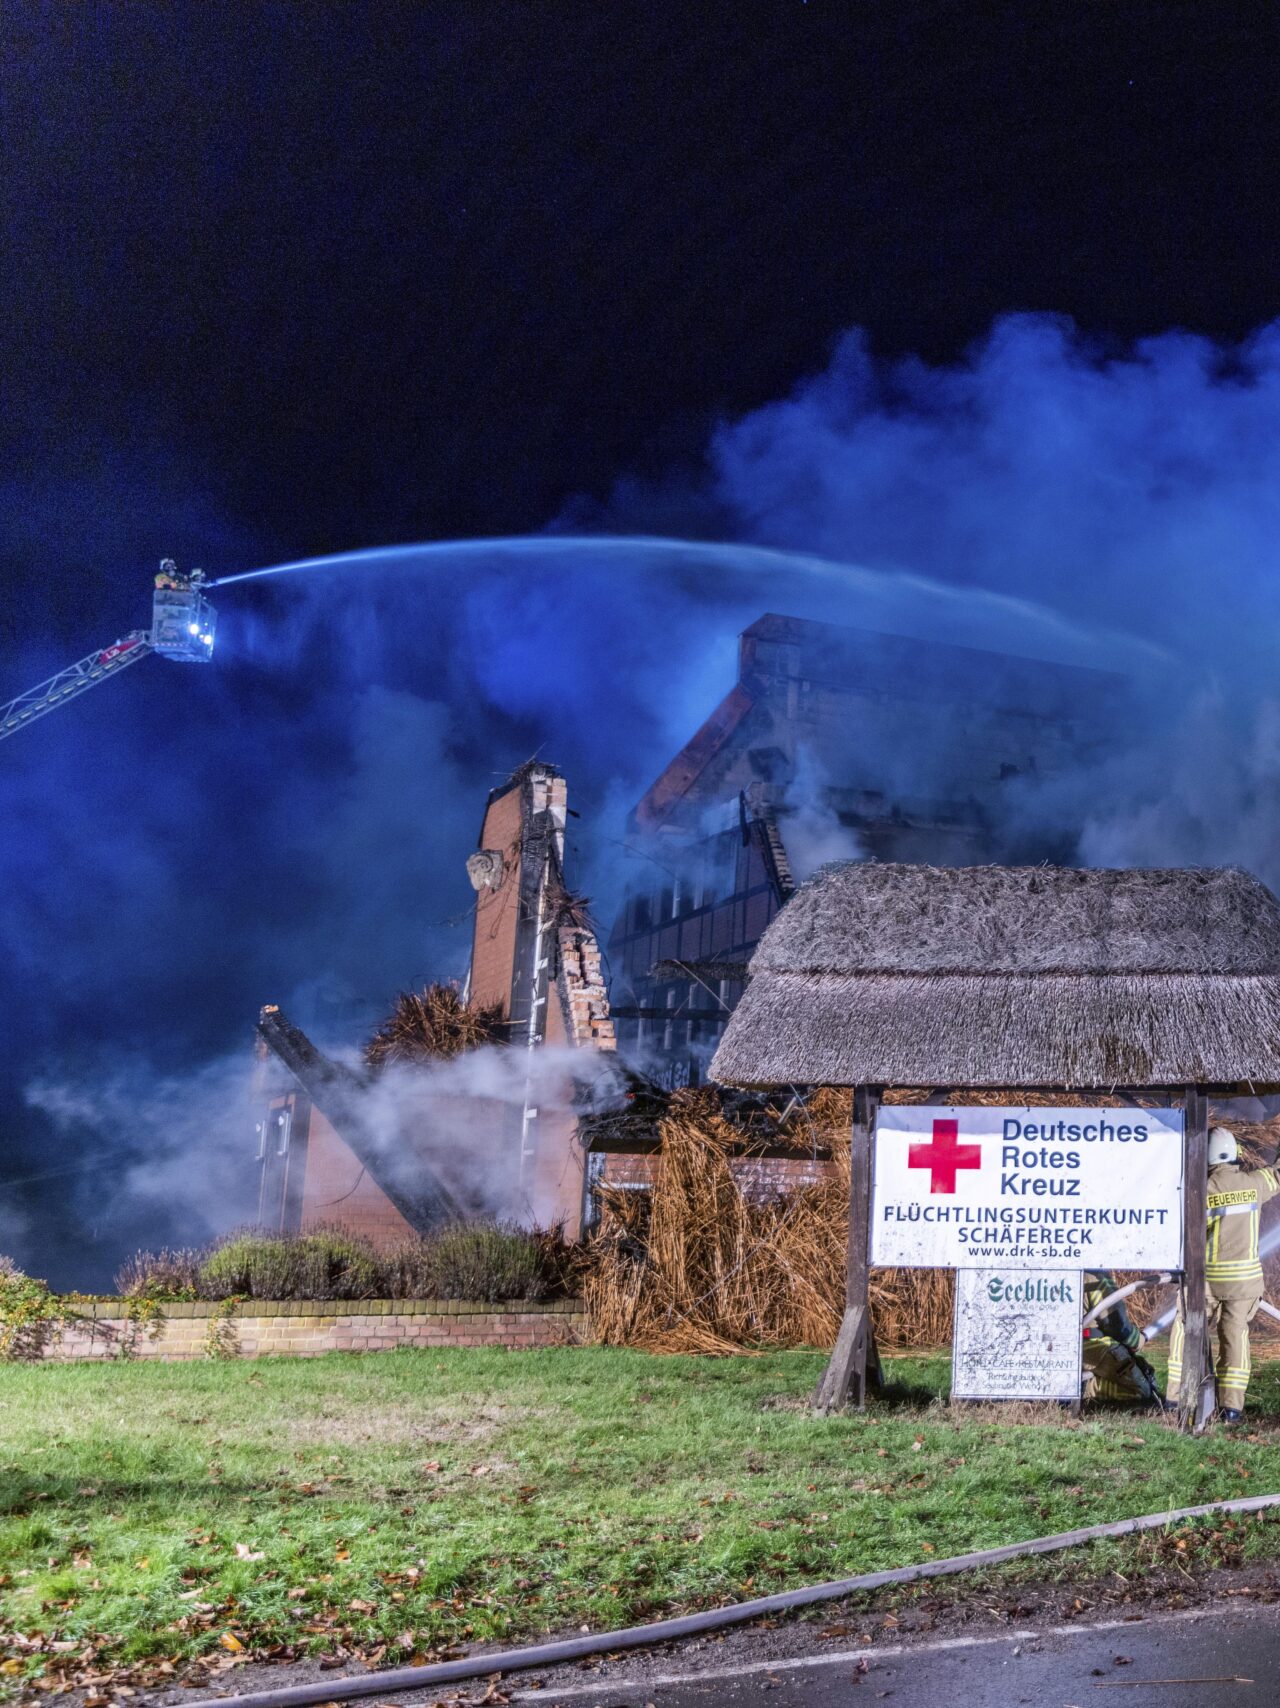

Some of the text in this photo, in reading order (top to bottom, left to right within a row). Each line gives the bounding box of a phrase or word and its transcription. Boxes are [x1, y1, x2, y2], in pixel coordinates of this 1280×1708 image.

[1002, 1118, 1149, 1143] Deutsches
[1001, 1145, 1081, 1169] Rotes
[1000, 1172, 1081, 1196] Kreuz
[1208, 1190, 1257, 1207] FEUERWEHR
[884, 1203, 1168, 1225] FLÜCHTLINGSUNTERKUNFT
[958, 1224, 1093, 1244] SCHÄFERECK
[968, 1245, 1082, 1258] www.drk-sb.de
[987, 1276, 1074, 1303] Seeblick
